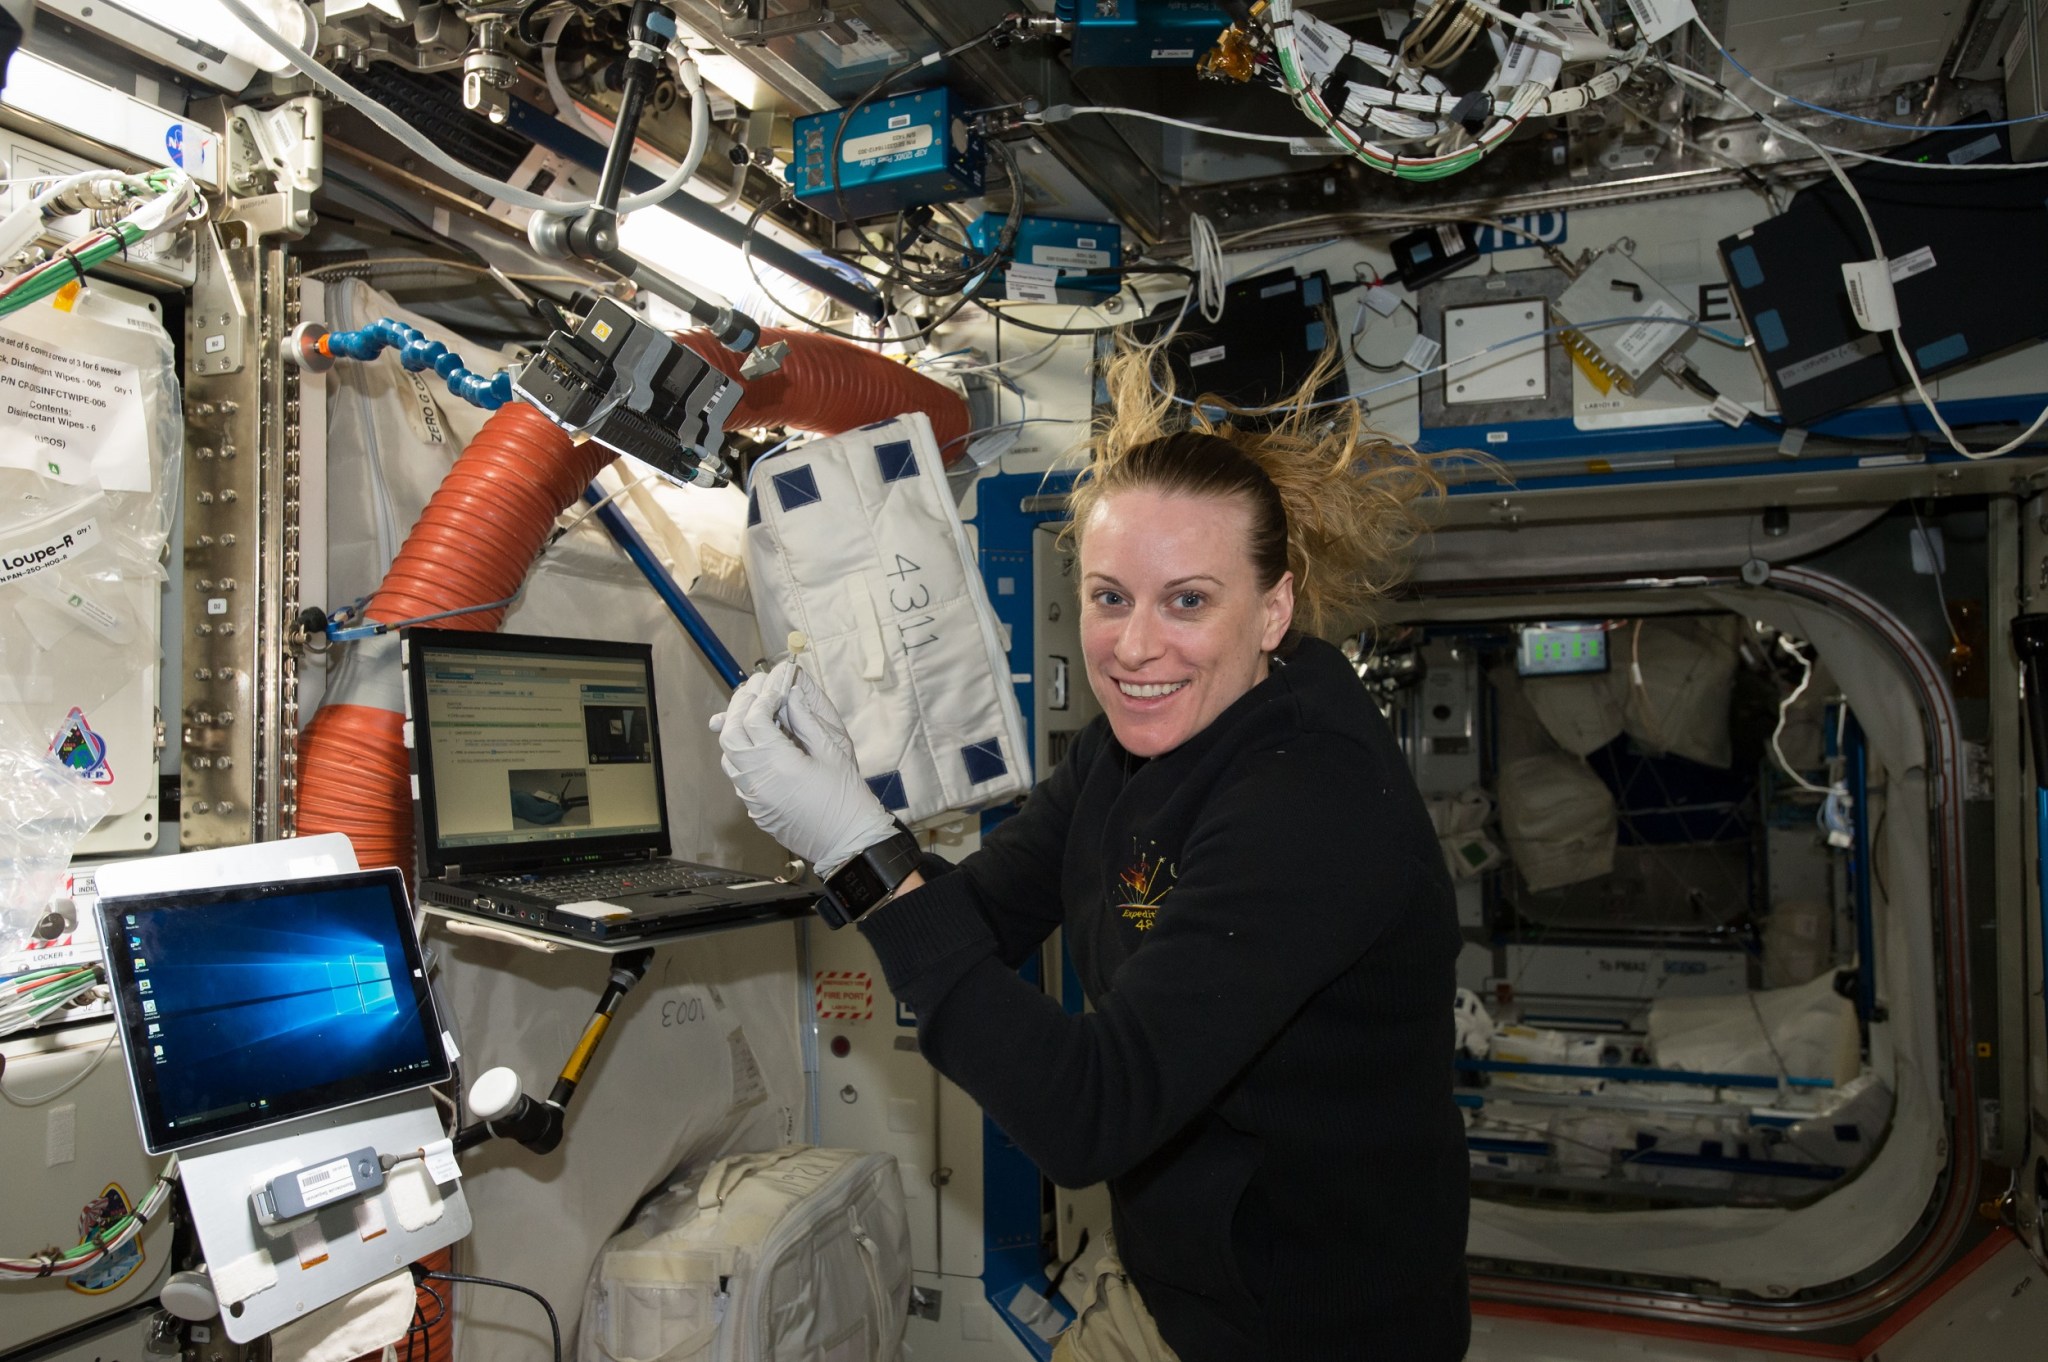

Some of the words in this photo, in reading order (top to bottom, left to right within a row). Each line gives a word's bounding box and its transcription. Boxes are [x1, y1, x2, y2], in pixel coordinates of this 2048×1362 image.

[859, 158, 876, 168] Supply
[6, 338, 16, 347] set
[16, 340, 24, 350] of
[25, 343, 30, 351] 6
[77, 359, 81, 367] 3
[83, 361, 92, 371] for
[101, 366, 121, 377] weeks
[1, 375, 16, 387] P/N
[54, 370, 80, 384] Wipes
[87, 379, 102, 389] 006
[114, 385, 127, 396] Qty
[419, 393, 430, 404] G
[29, 400, 72, 416] Contents:
[7, 406, 55, 424] Disinfectant
[58, 417, 84, 430] Wipes
[91, 424, 96, 432] 6
[423, 407, 442, 443] ZERO
[2, 534, 75, 571] Loupe-R
[76, 526, 87, 537] Qty
[886, 554, 940, 656] 4311
[79, 885, 98, 893] INDIC
[1122, 909, 1156, 919] Expedit
[33, 952, 63, 961] LOCKER
[823, 991, 841, 1000] FIRE
[843, 991, 864, 1001] PORT
